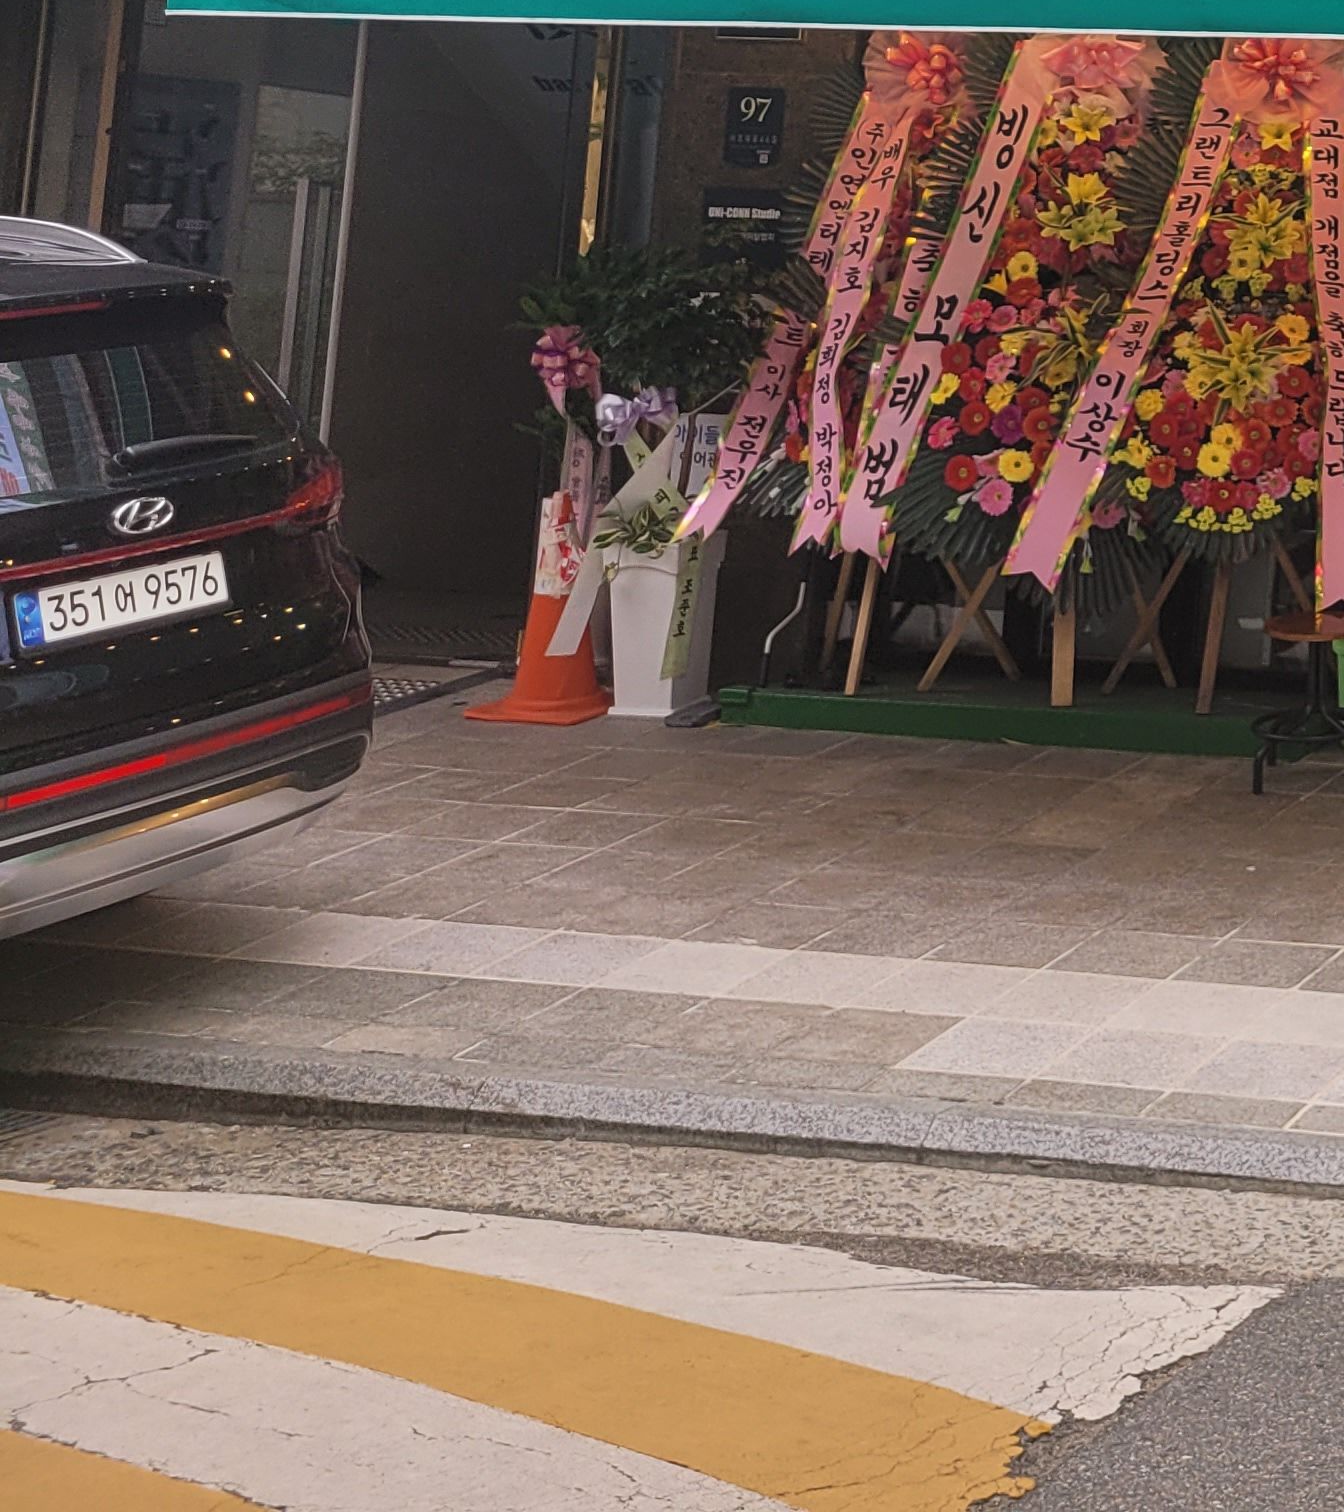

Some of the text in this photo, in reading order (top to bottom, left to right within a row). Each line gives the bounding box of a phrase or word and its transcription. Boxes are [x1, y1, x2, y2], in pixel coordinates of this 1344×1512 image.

[739, 95, 773, 123] 97
[1311, 119, 1344, 200] 교대점
[1066, 108, 1233, 462] 그랜트리홀딩스 회장 이상수
[1315, 215, 1344, 298] 개점을
[813, 138, 903, 517] 배우 김지호 김희정 박정아
[718, 415, 767, 489] 전우진
